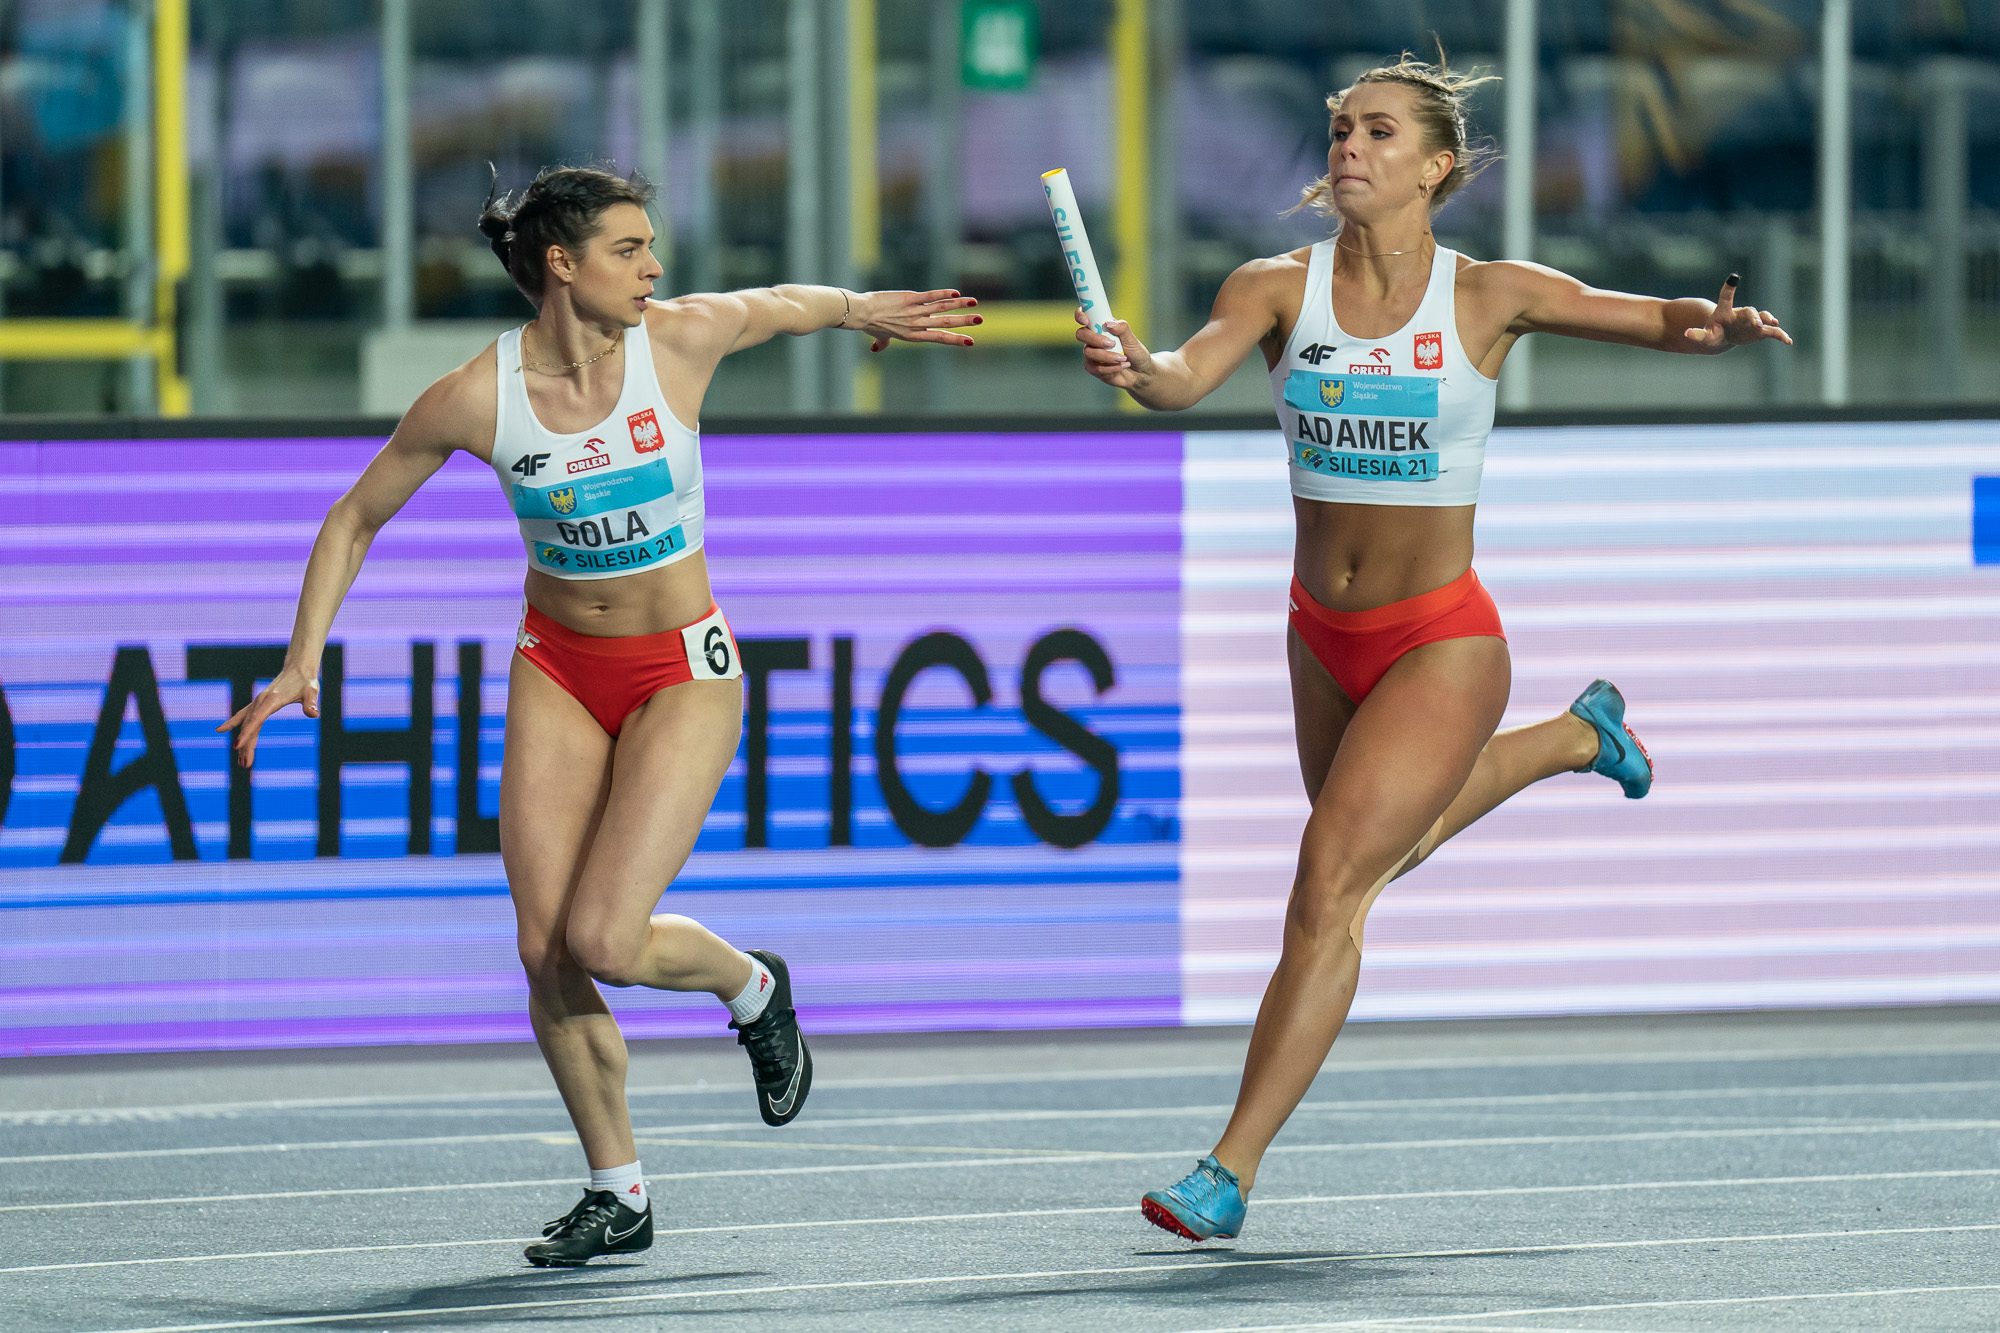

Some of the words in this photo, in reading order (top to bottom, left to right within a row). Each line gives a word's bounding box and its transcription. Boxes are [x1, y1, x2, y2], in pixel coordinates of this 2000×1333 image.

[1415, 333, 1440, 341] POLSKA
[1299, 342, 1338, 366] 4F
[1350, 365, 1390, 376] ORLEN
[1352, 381, 1403, 392] Województwo
[1352, 390, 1378, 401] Śląskie
[629, 410, 654, 424] POLSKA
[1298, 413, 1431, 452] ADAMEK
[511, 453, 552, 477] 4F
[568, 455, 610, 474] ORLEN
[1328, 456, 1402, 477] SILESIA
[1407, 458, 1428, 475] 21
[581, 475, 634, 492] Województwo
[583, 489, 612, 502] Śląskie
[556, 510, 650, 548] GOLA
[575, 546, 652, 569] SILESIA
[655, 534, 675, 556] 21
[703, 625, 730, 676] 6
[59, 627, 1119, 865] ATHLTICS
